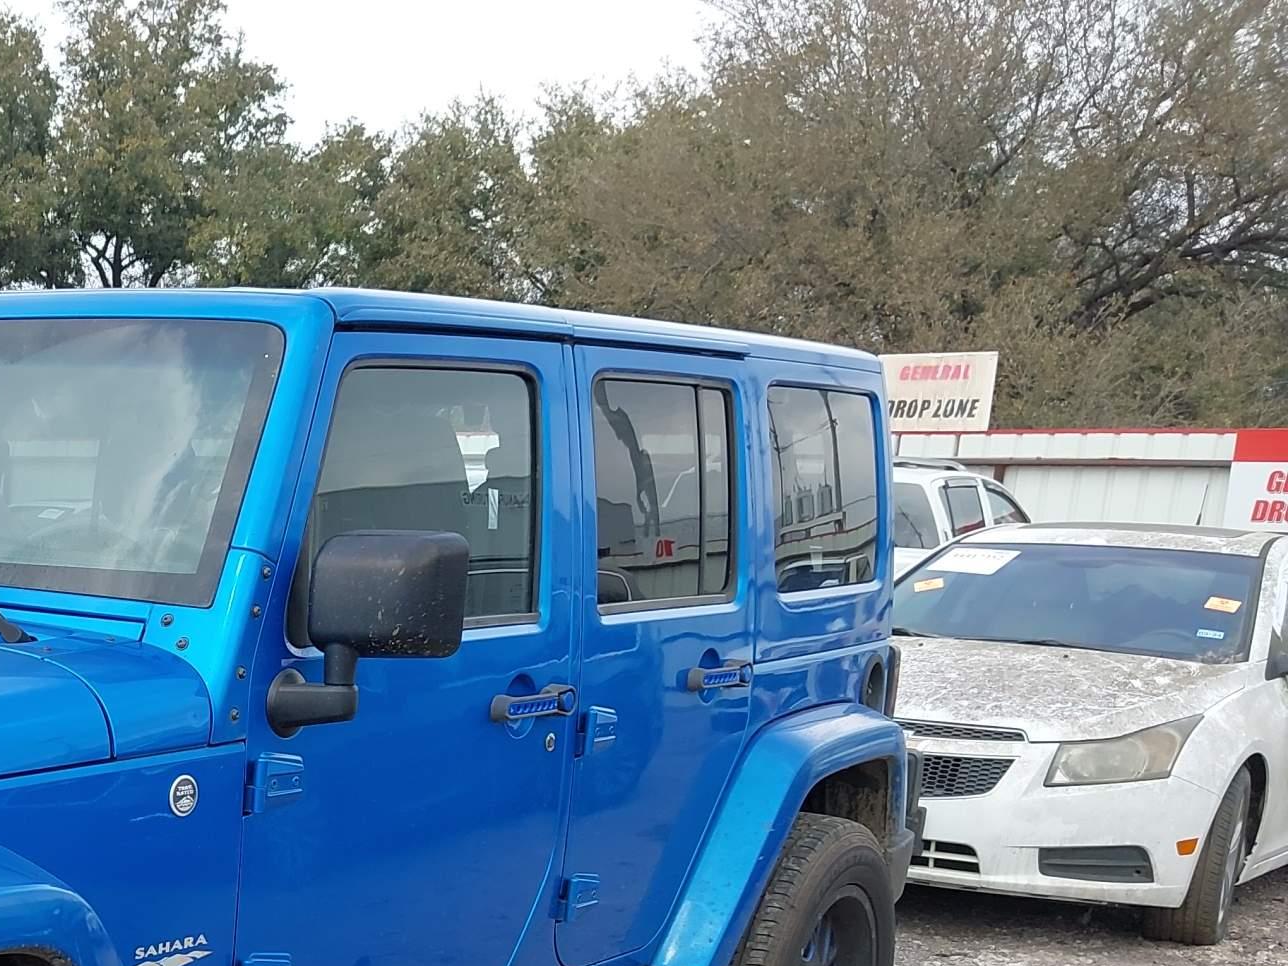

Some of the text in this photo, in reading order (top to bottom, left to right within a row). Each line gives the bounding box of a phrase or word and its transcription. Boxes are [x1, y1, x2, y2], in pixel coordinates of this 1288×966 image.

[899, 363, 971, 381] GENERAL
[932, 398, 980, 419] ZONE
[1250, 500, 1288, 523] DR
[134, 934, 208, 960] SAHARA
